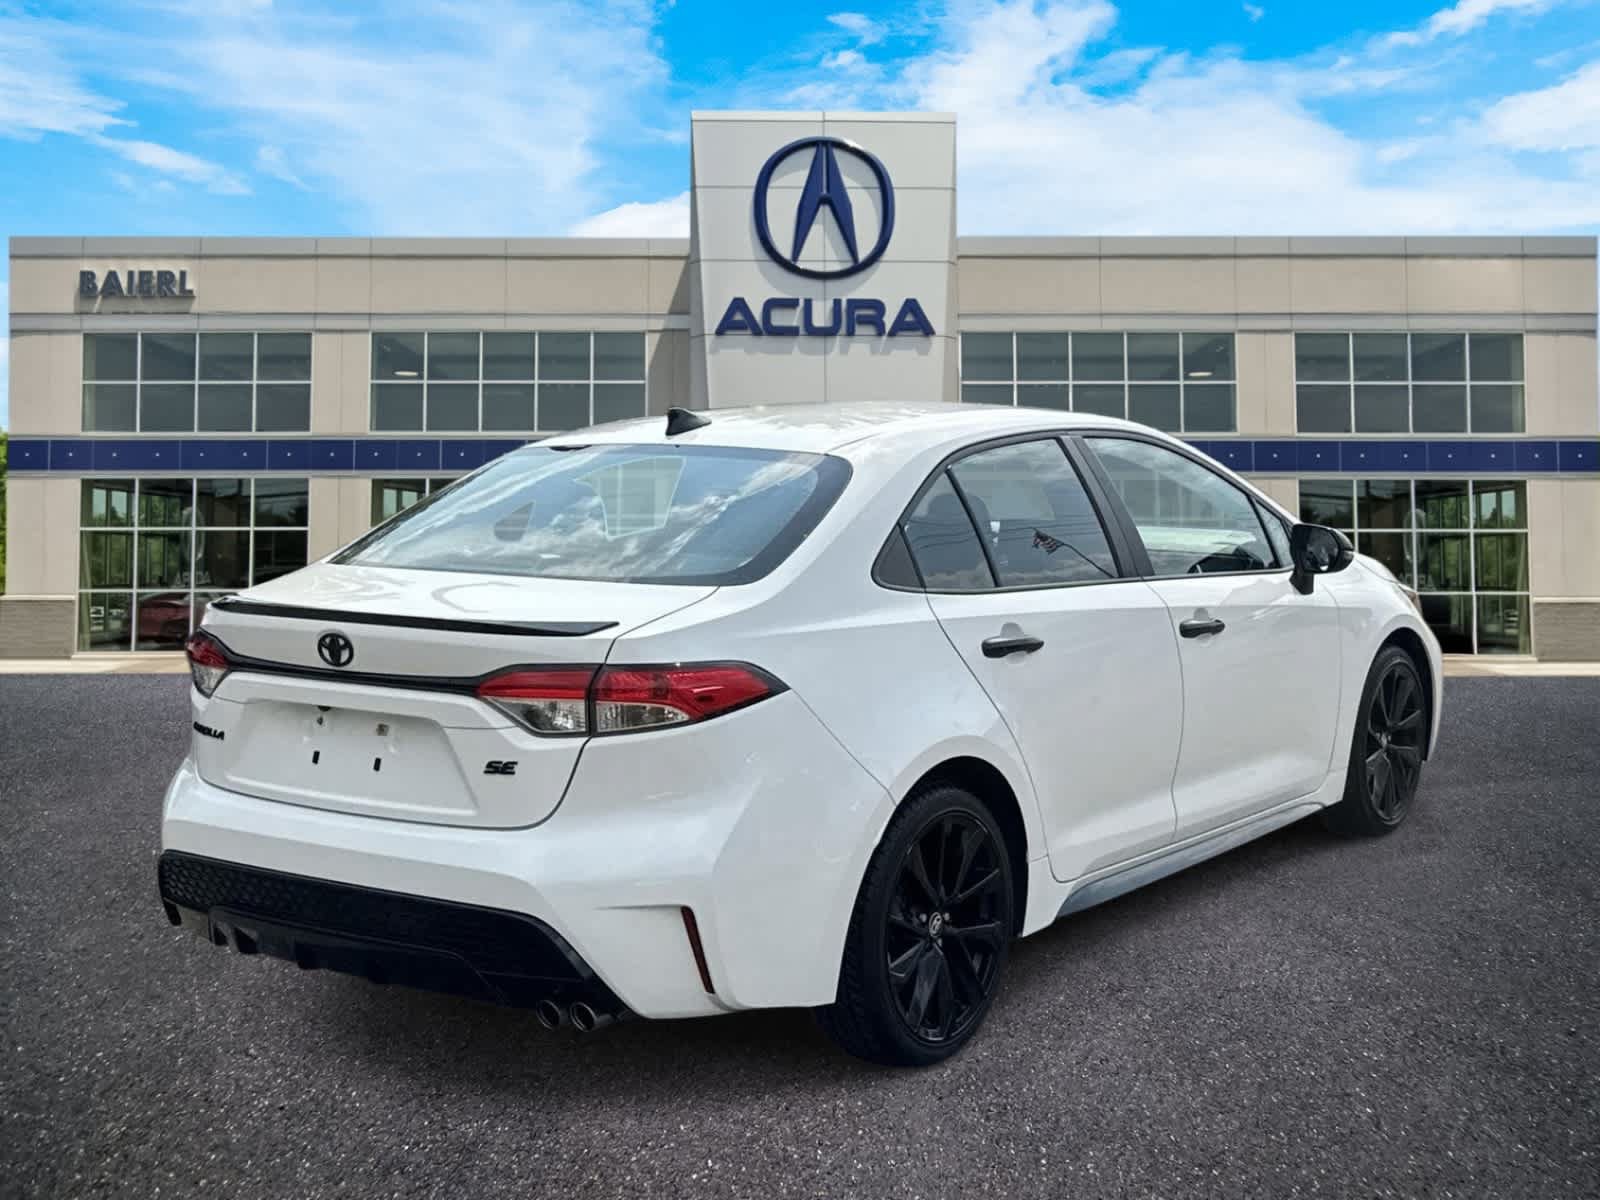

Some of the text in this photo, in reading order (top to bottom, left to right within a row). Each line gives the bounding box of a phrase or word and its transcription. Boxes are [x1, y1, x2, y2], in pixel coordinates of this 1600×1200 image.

[79, 270, 194, 297] BAIERL
[715, 297, 936, 336] ACURA
[483, 760, 518, 775] SE
